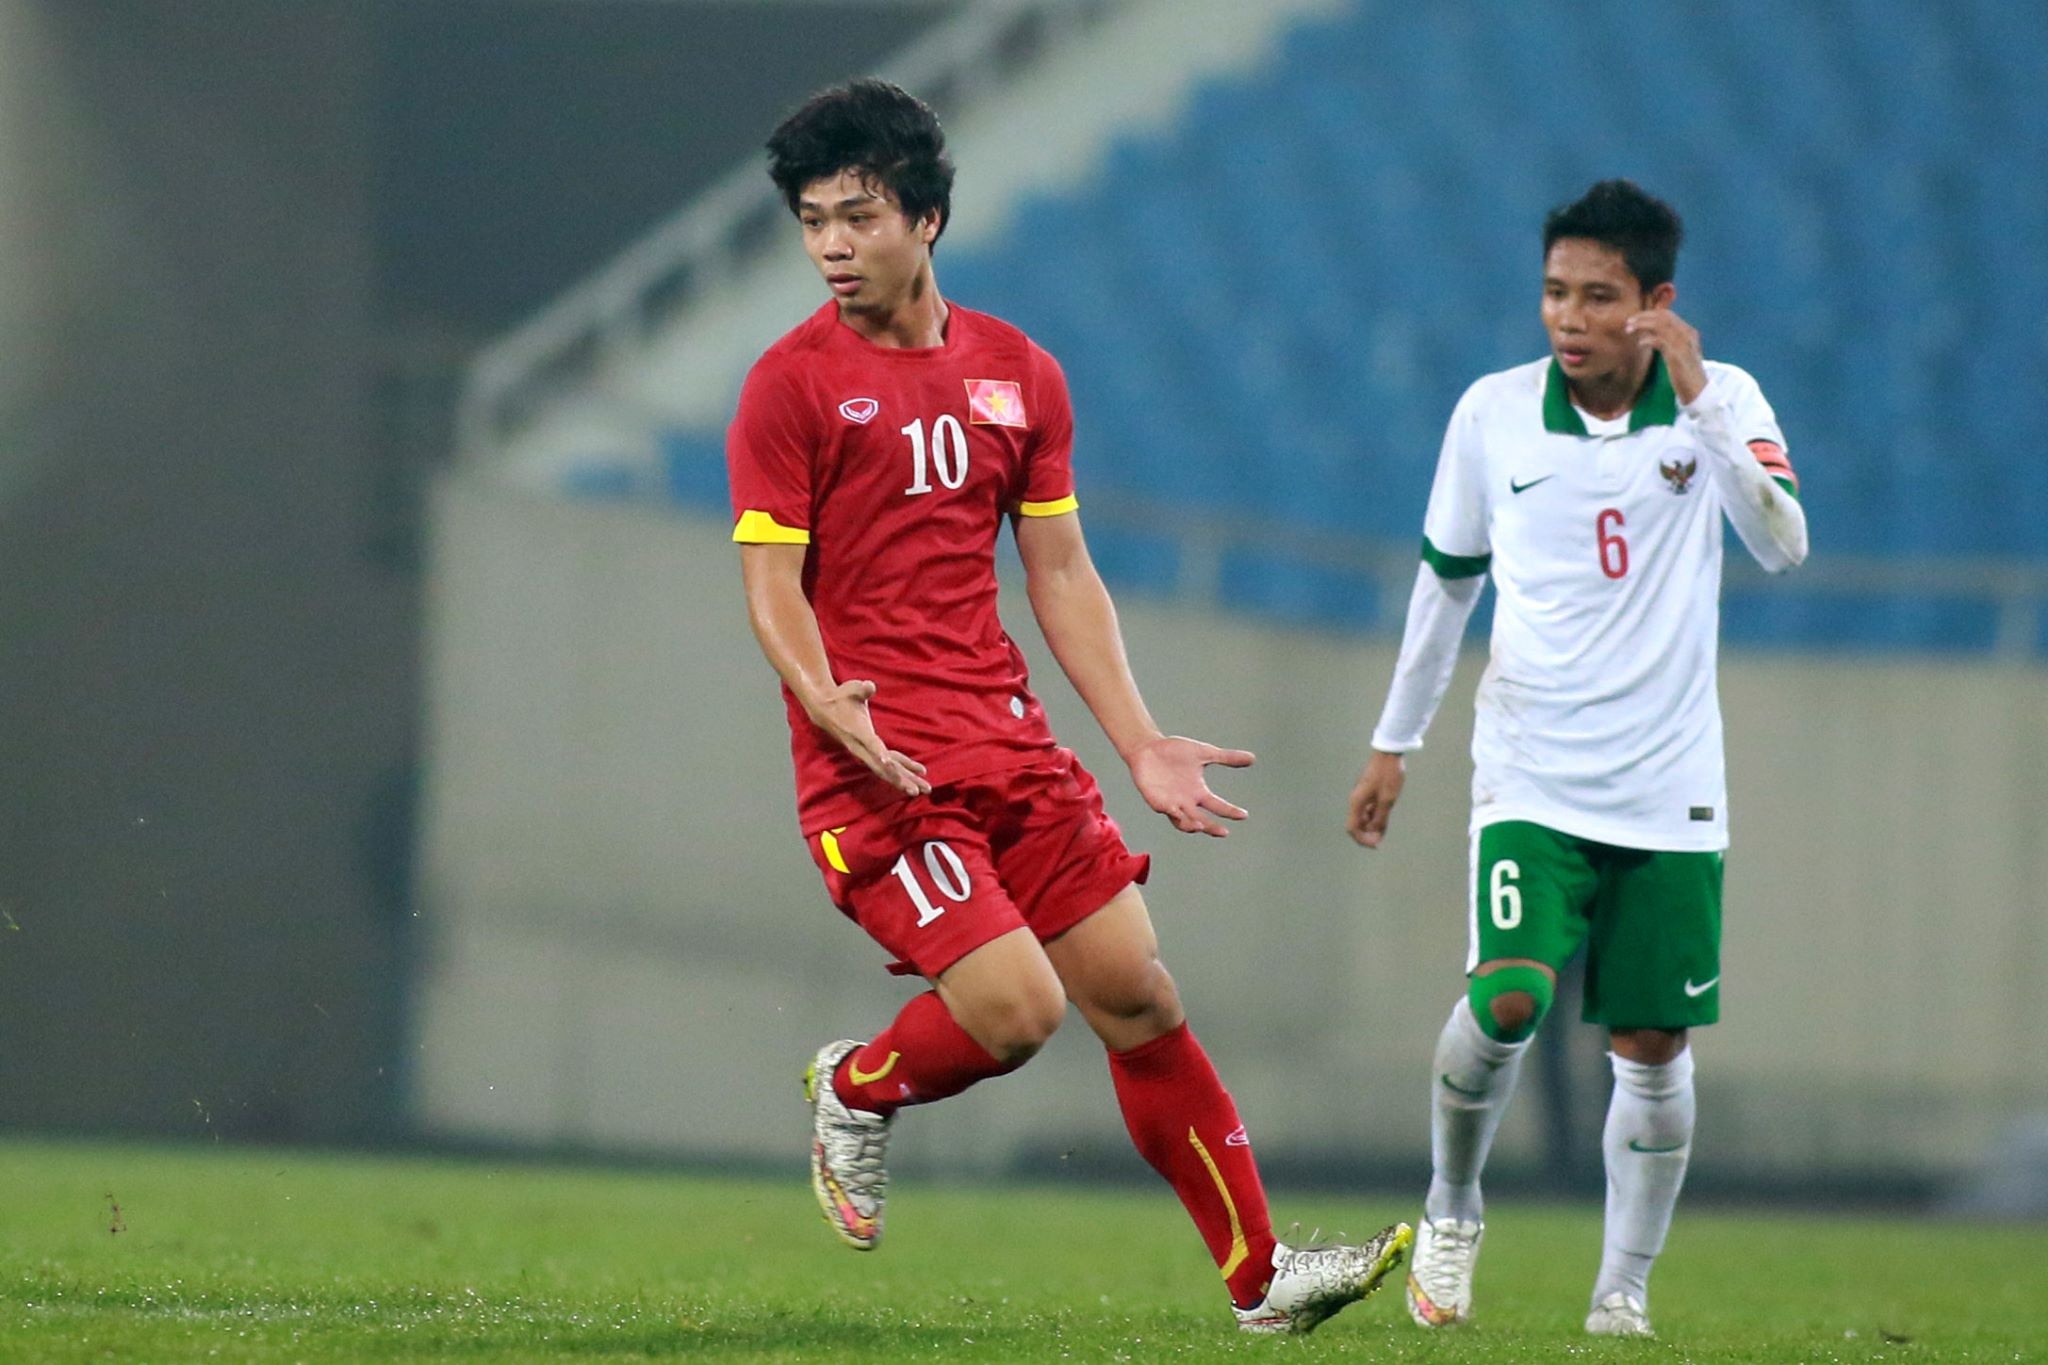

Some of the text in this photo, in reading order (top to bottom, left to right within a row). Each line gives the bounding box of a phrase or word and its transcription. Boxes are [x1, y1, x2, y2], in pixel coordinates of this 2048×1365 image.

[901, 414, 969, 496] 10
[1596, 508, 1629, 579] 6
[890, 841, 971, 928] 10
[1490, 859, 1523, 930] 6
